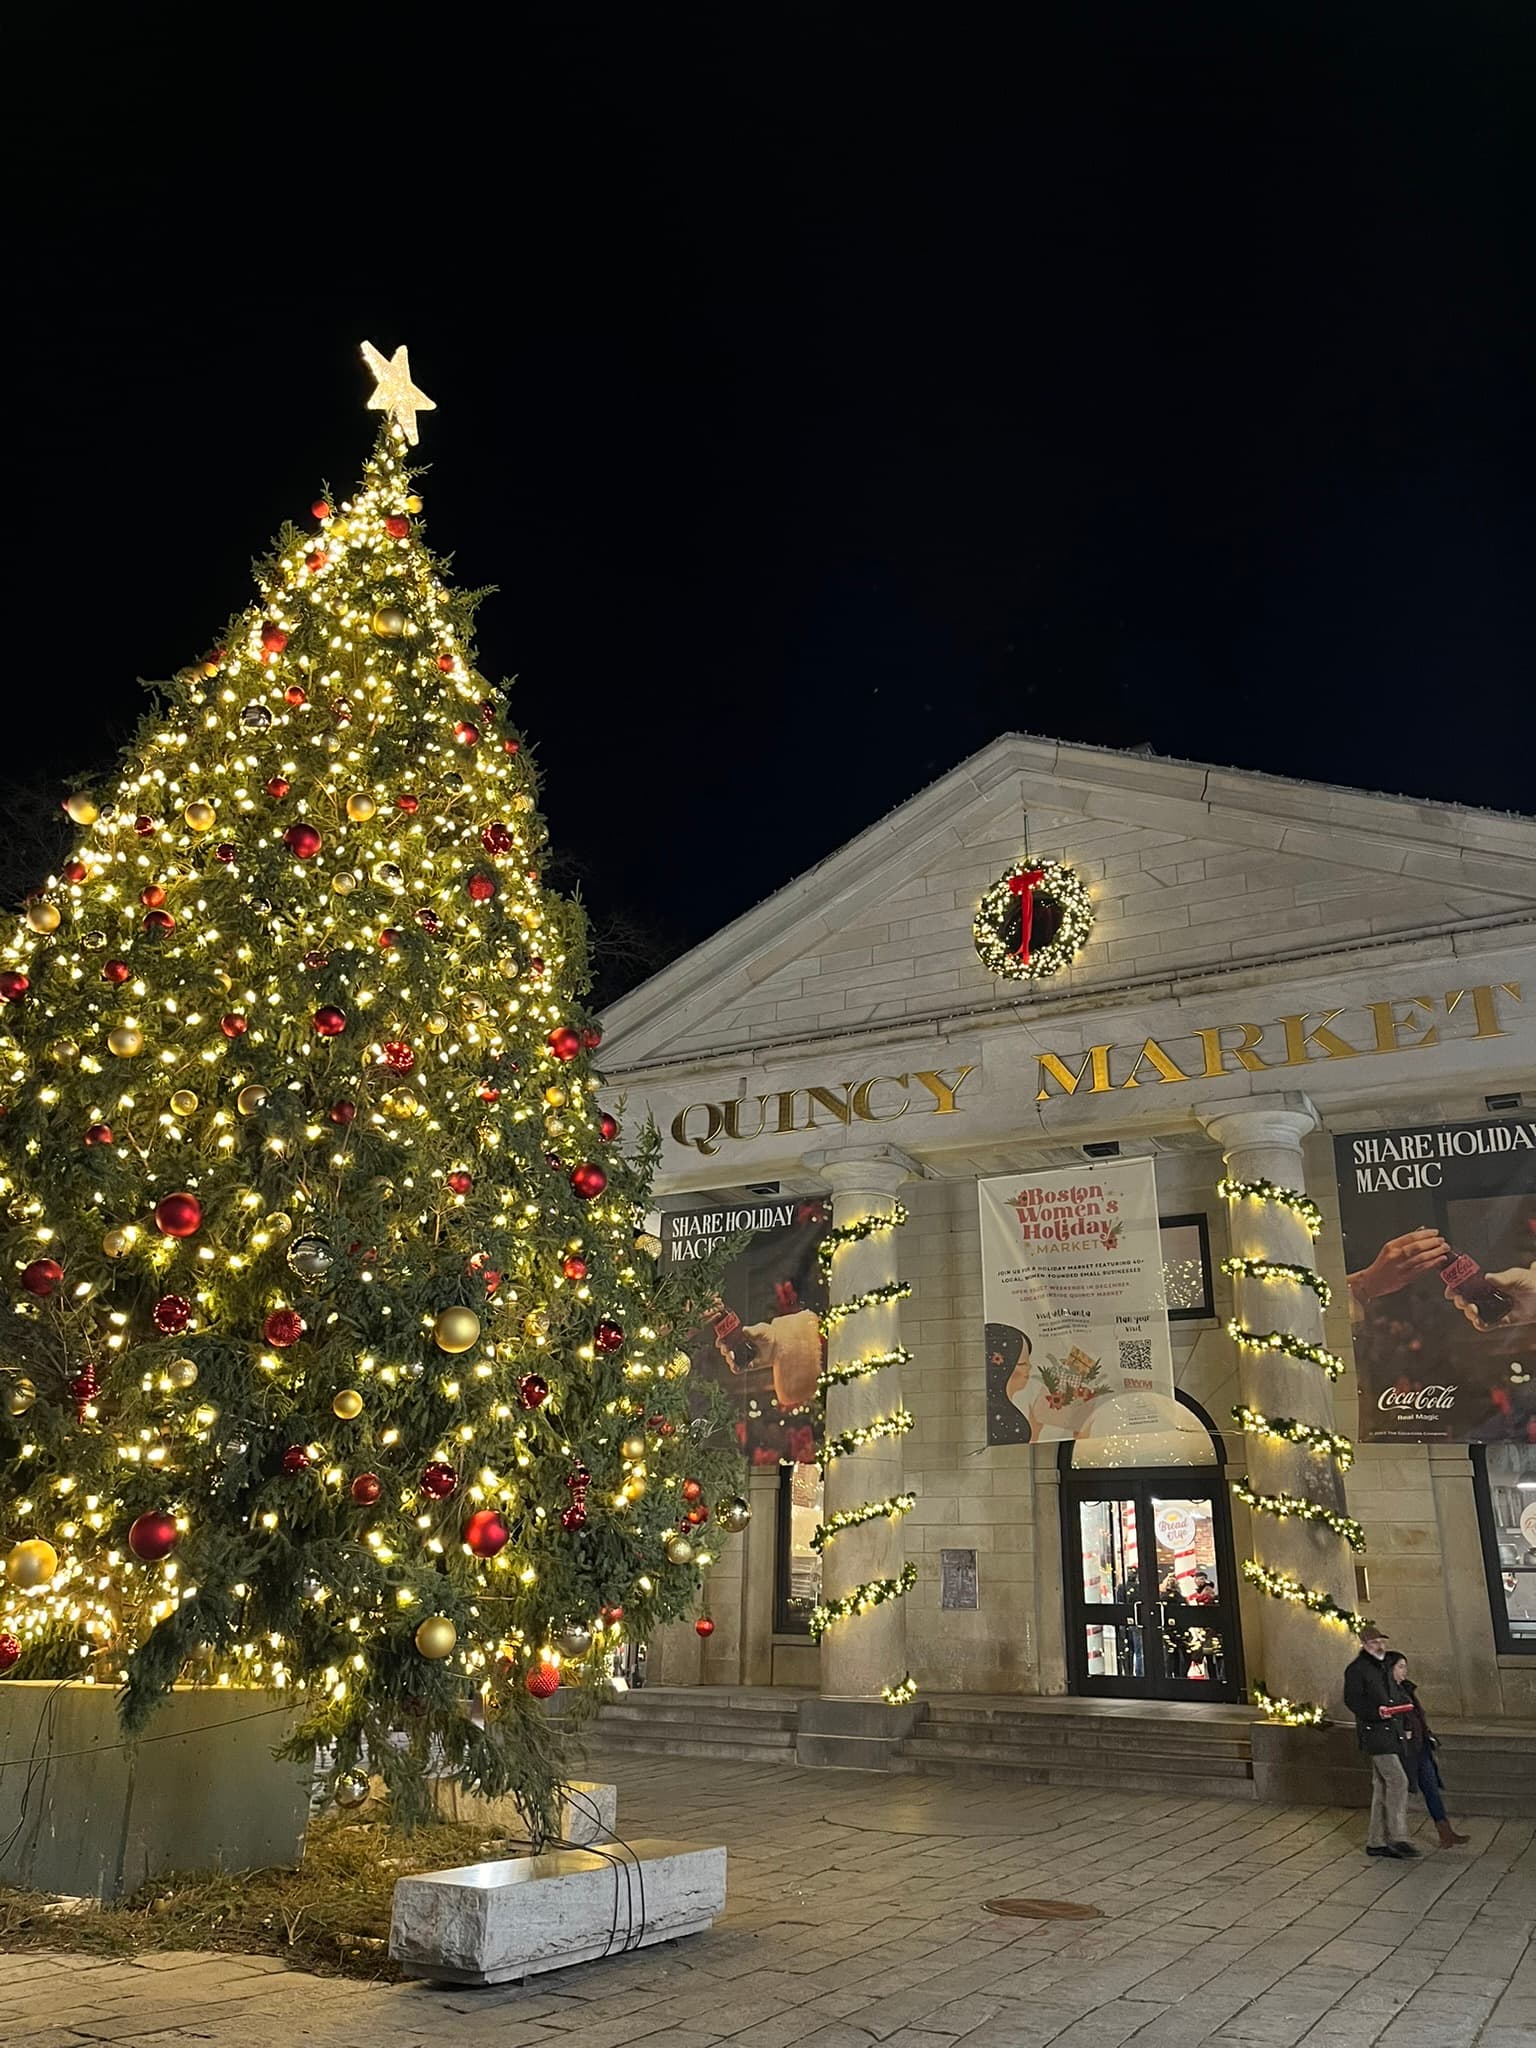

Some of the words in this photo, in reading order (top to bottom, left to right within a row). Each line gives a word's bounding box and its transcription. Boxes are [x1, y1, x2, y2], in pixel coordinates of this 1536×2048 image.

[671, 1065, 979, 1156] QUINCY
[1031, 983, 1522, 1101] MARKET
[1352, 1133, 1435, 1165] SHARE
[1356, 1162, 1443, 1194] MAGIC
[1025, 1185, 1104, 1206] Boston
[672, 1212, 724, 1238] SHARE
[725, 1204, 795, 1232] HOLIDAY
[1016, 1199, 1119, 1224] Women's
[1023, 1217, 1113, 1242] Holiday
[1037, 1239, 1099, 1254] MARKET
[1095, 1260, 1131, 1268] FEATURING
[1377, 1385, 1459, 1411] Coca-Cola
[1415, 1413, 1439, 1421] Magic
